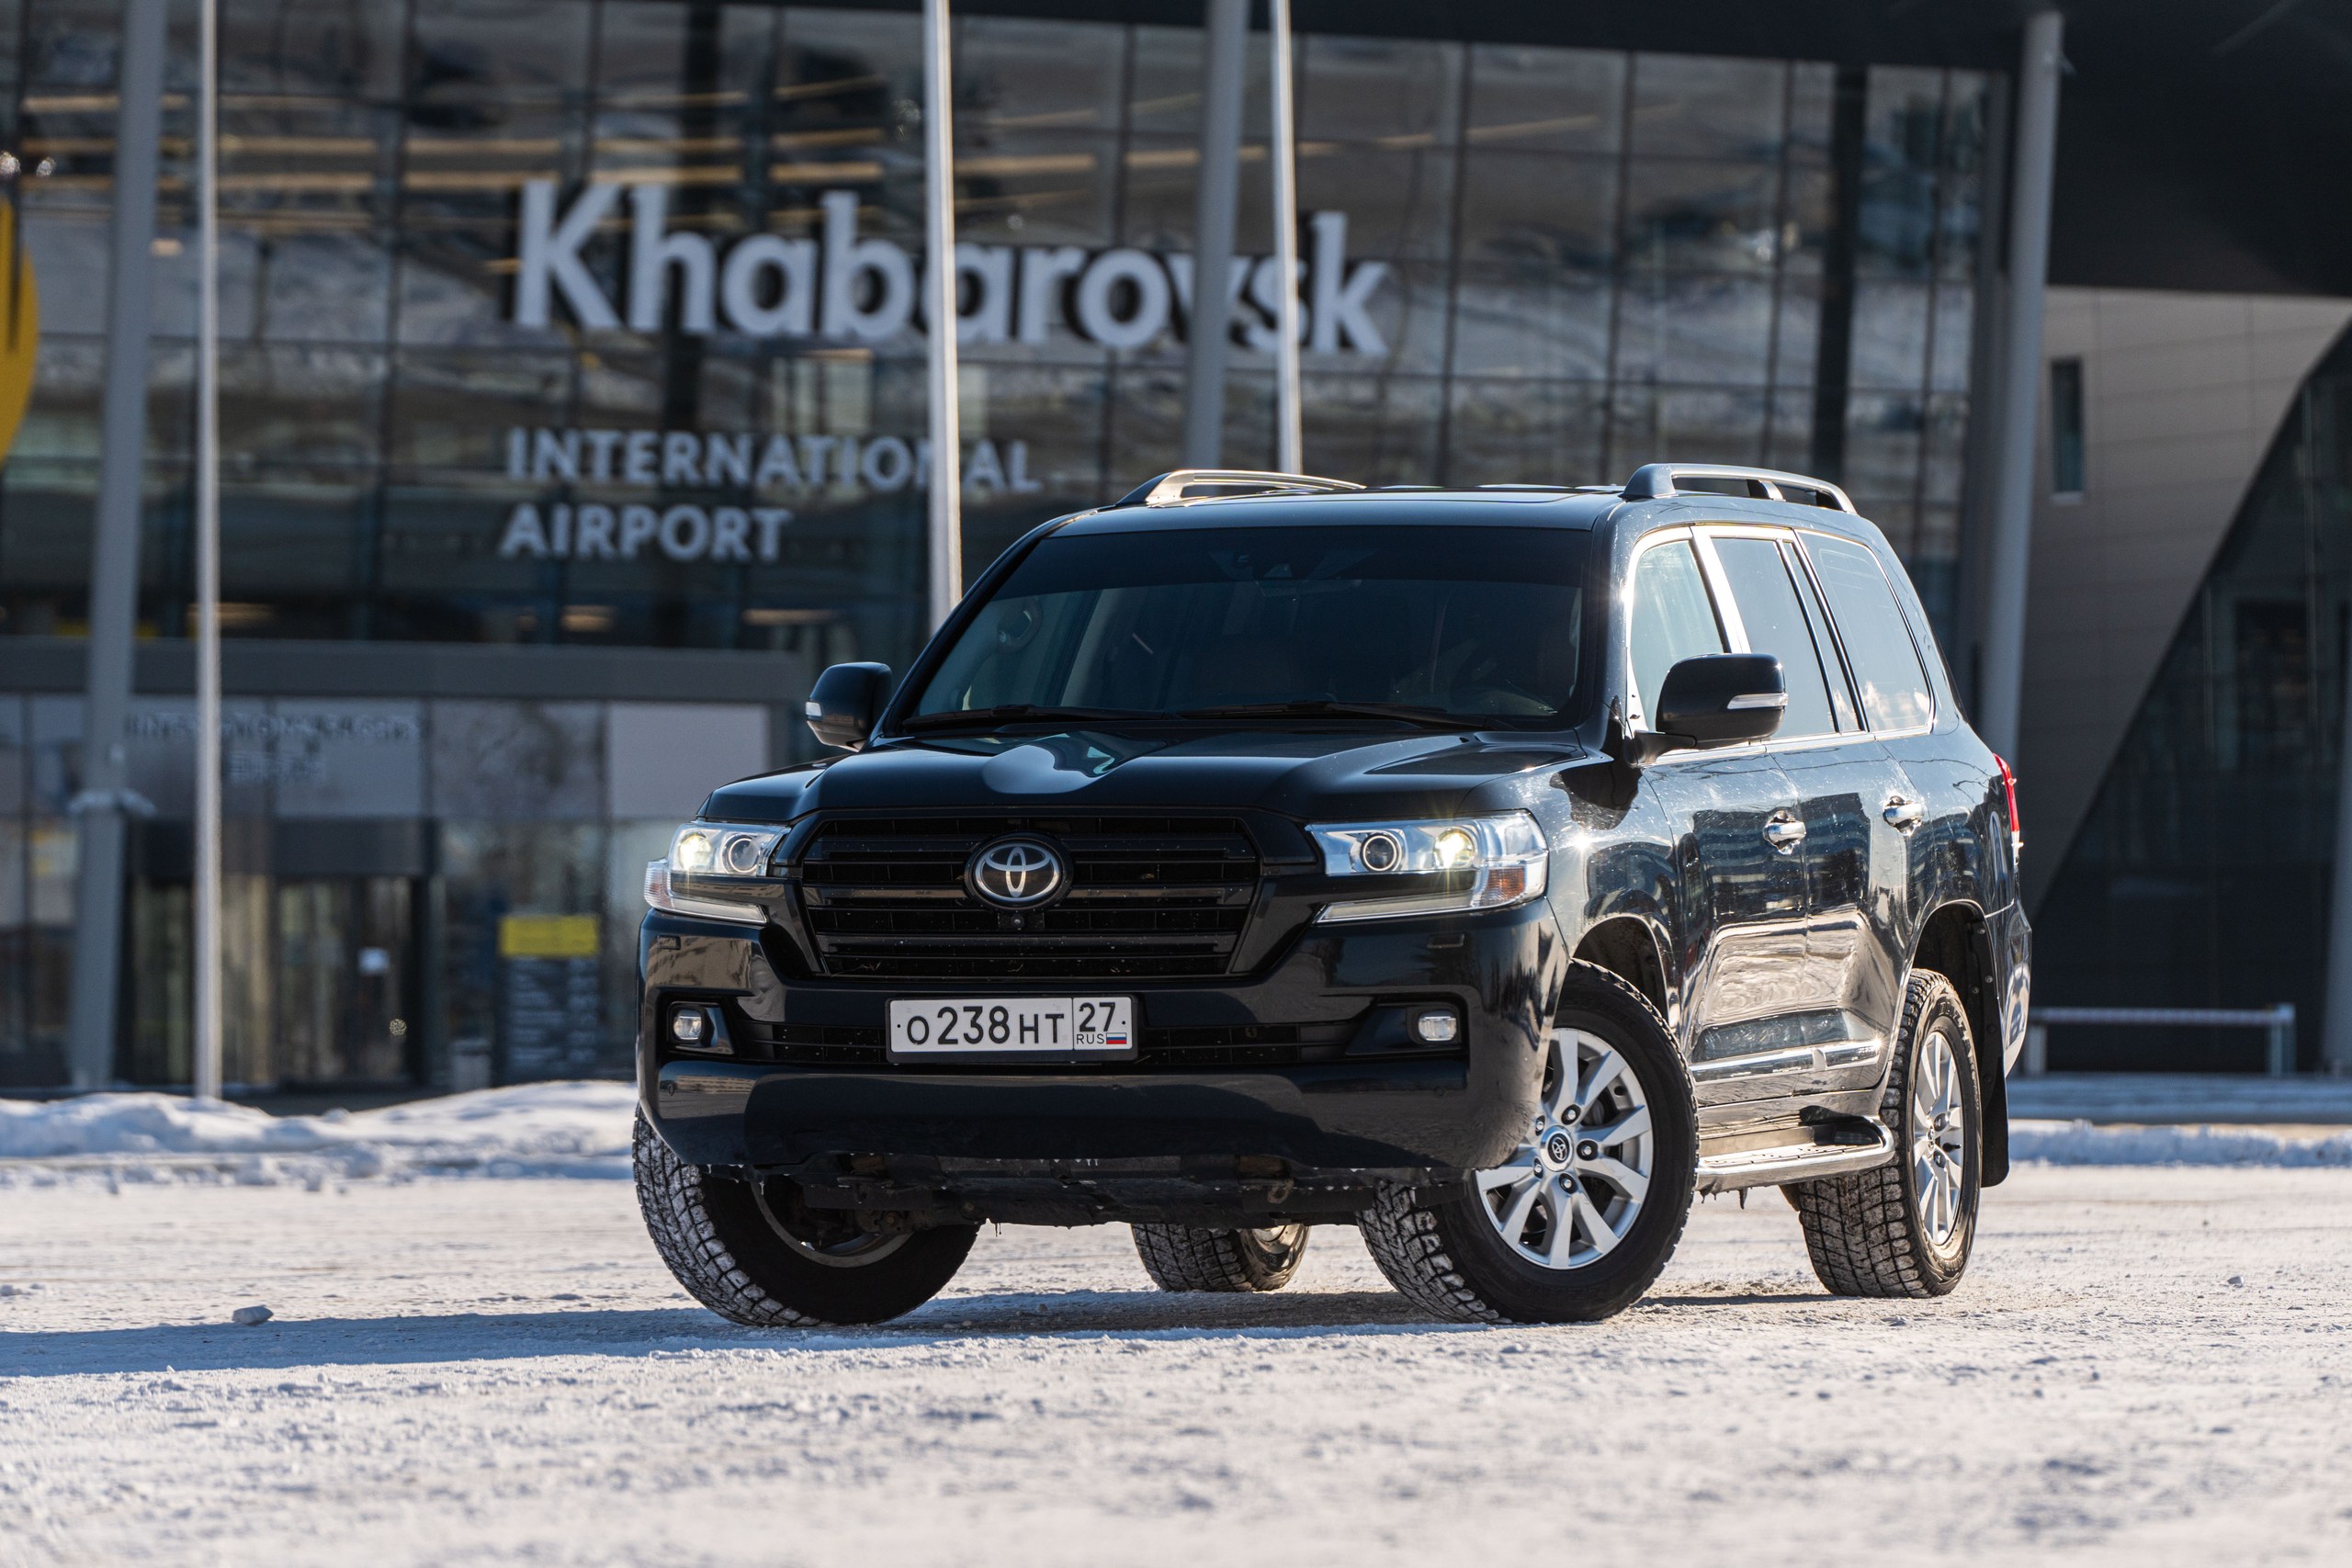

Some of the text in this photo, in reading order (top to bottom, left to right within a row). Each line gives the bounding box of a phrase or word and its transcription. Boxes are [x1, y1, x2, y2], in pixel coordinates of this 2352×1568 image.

[499, 502, 794, 562] AIRPORT
[1079, 1002, 1116, 1032] 27
[1076, 1033, 1105, 1045] RUS
